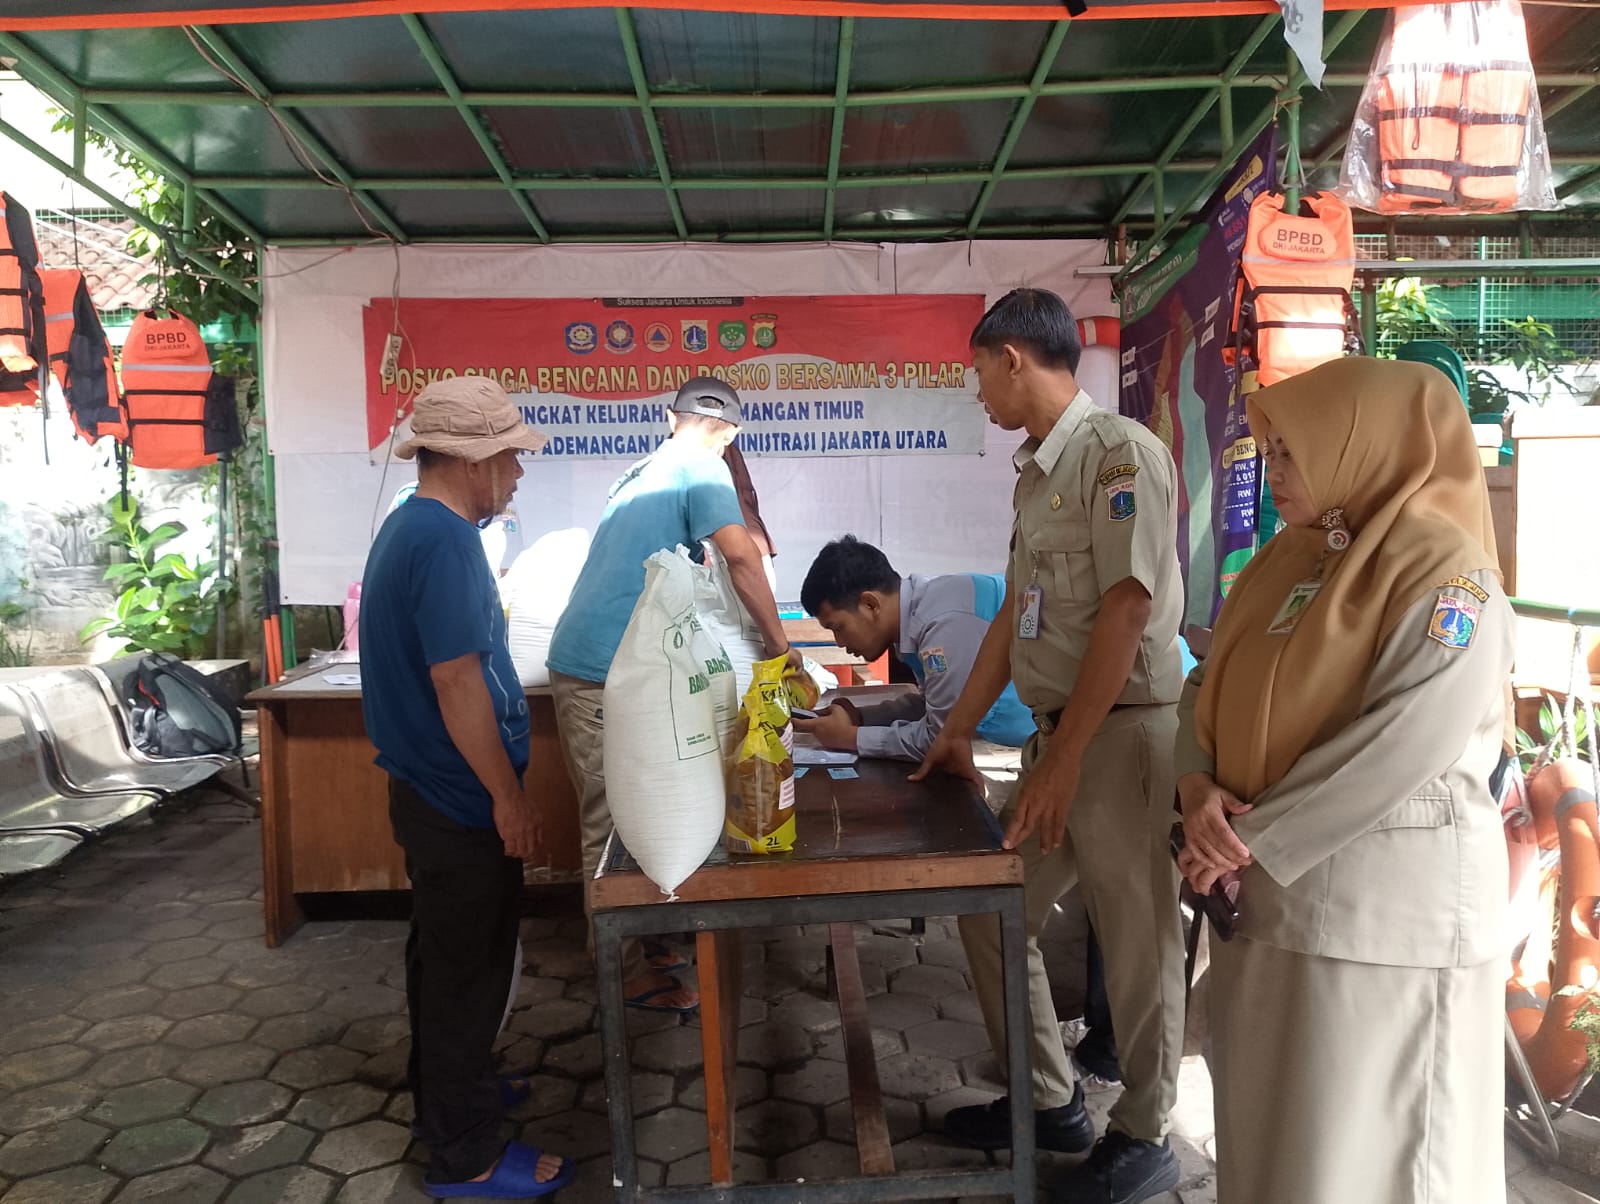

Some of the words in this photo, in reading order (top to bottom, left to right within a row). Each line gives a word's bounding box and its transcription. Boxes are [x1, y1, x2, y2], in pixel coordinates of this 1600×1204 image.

[1277, 229, 1323, 246] BPBD
[1288, 244, 1326, 255] JAKARTA
[616, 297, 645, 306] Sukses
[645, 297, 673, 306] Jakarta
[674, 297, 697, 306] Untuk
[697, 297, 733, 306] Indonesia
[146, 332, 187, 344] BPBD
[537, 365, 640, 393] BENCANA
[646, 365, 691, 392] DAN
[776, 361, 881, 389] BERSAMA
[884, 361, 898, 389] 3
[903, 361, 966, 389] PILAR
[518, 404, 581, 425] INGKAT
[586, 403, 671, 425] KELURAH
[740, 401, 810, 422] MANGAN
[814, 400, 864, 420] TIMUR
[531, 434, 650, 456] ADEMANGAN
[821, 430, 892, 453] JAKARTA
[896, 430, 948, 449] UTARA
[766, 836, 781, 847] 2L
